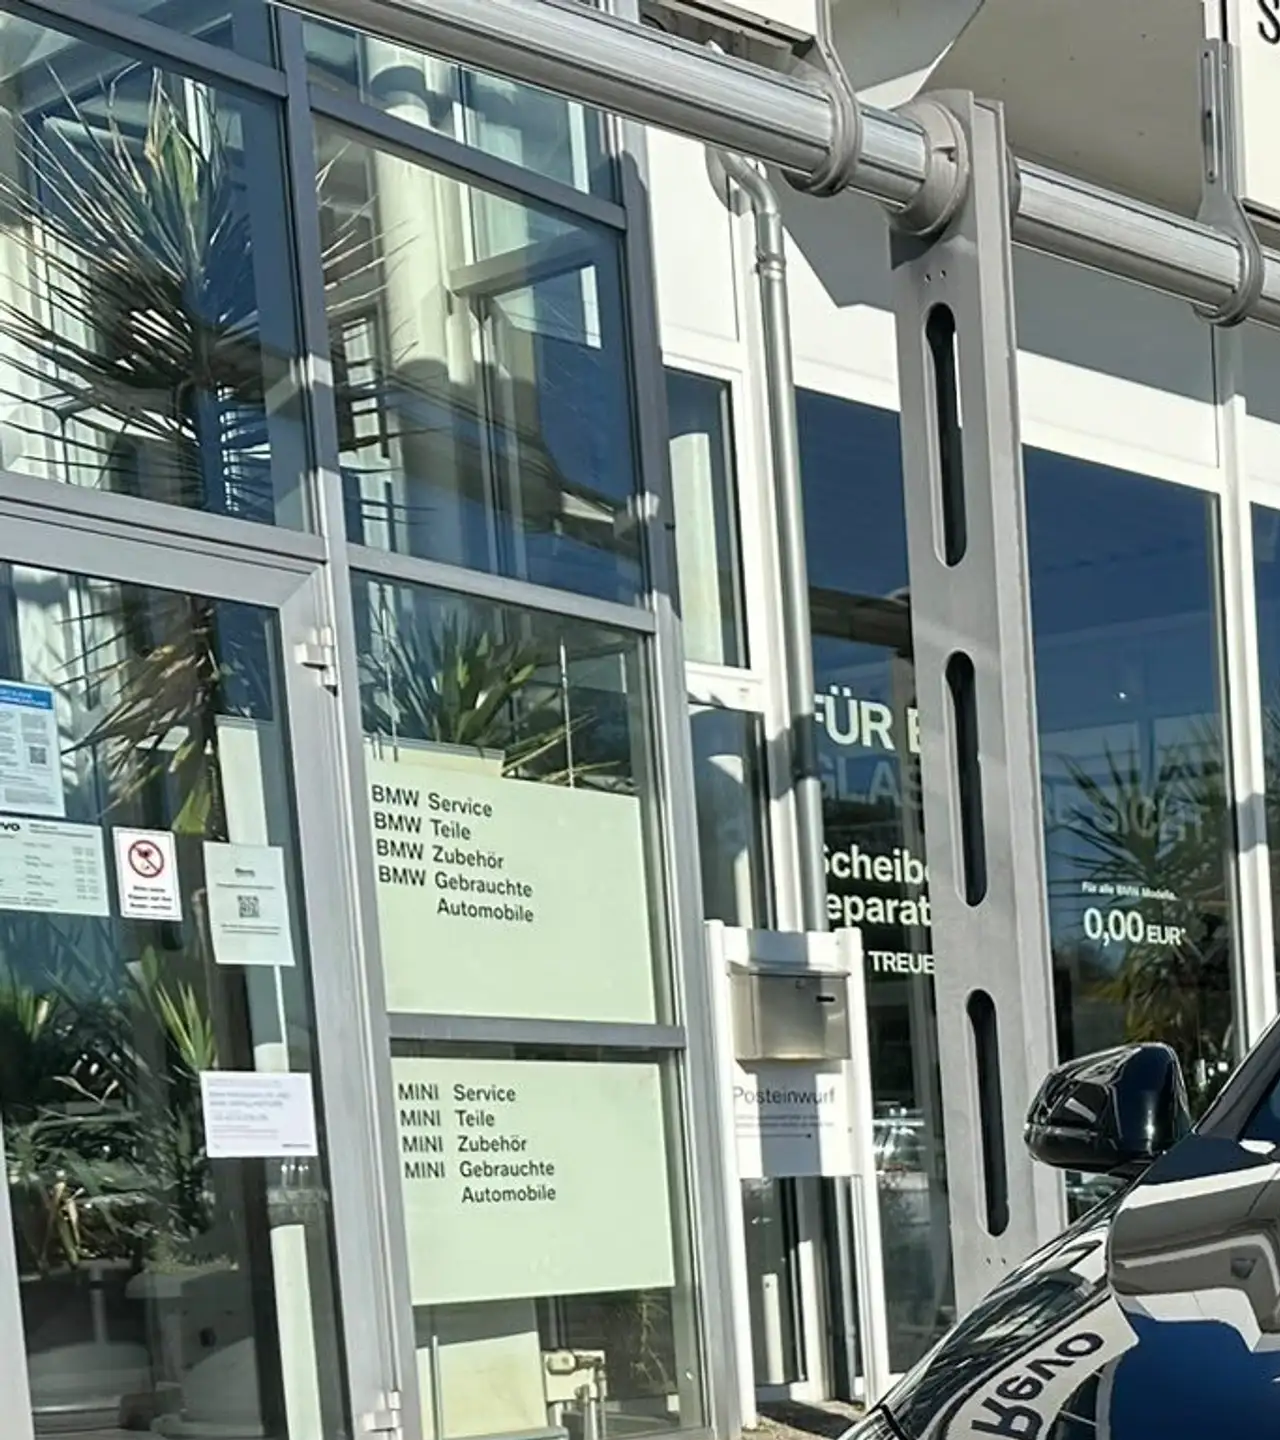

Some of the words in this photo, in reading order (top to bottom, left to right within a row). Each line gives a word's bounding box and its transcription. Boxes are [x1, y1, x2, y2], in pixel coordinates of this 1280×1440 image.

[371, 784, 420, 808] BMW
[428, 792, 493, 818] Service
[373, 811, 422, 834] BMW
[430, 818, 472, 840] Teile
[376, 838, 424, 861] BMW
[432, 845, 504, 869] Zubehör
[378, 864, 426, 887] BMW
[434, 871, 533, 897] Gebrauchte
[437, 898, 534, 922] Automobile
[1083, 907, 1144, 946] 0,00
[398, 1083, 439, 1101] MINI
[453, 1084, 516, 1101] Service
[733, 1086, 834, 1104] Posteinwurf
[400, 1110, 441, 1126] MINI
[455, 1110, 495, 1127] Teile
[402, 1136, 443, 1152] MINI
[457, 1135, 527, 1152] Zubehör
[405, 1162, 445, 1178] MINI
[459, 1160, 555, 1178] Gebrauchte
[461, 1184, 556, 1203] Automobile
